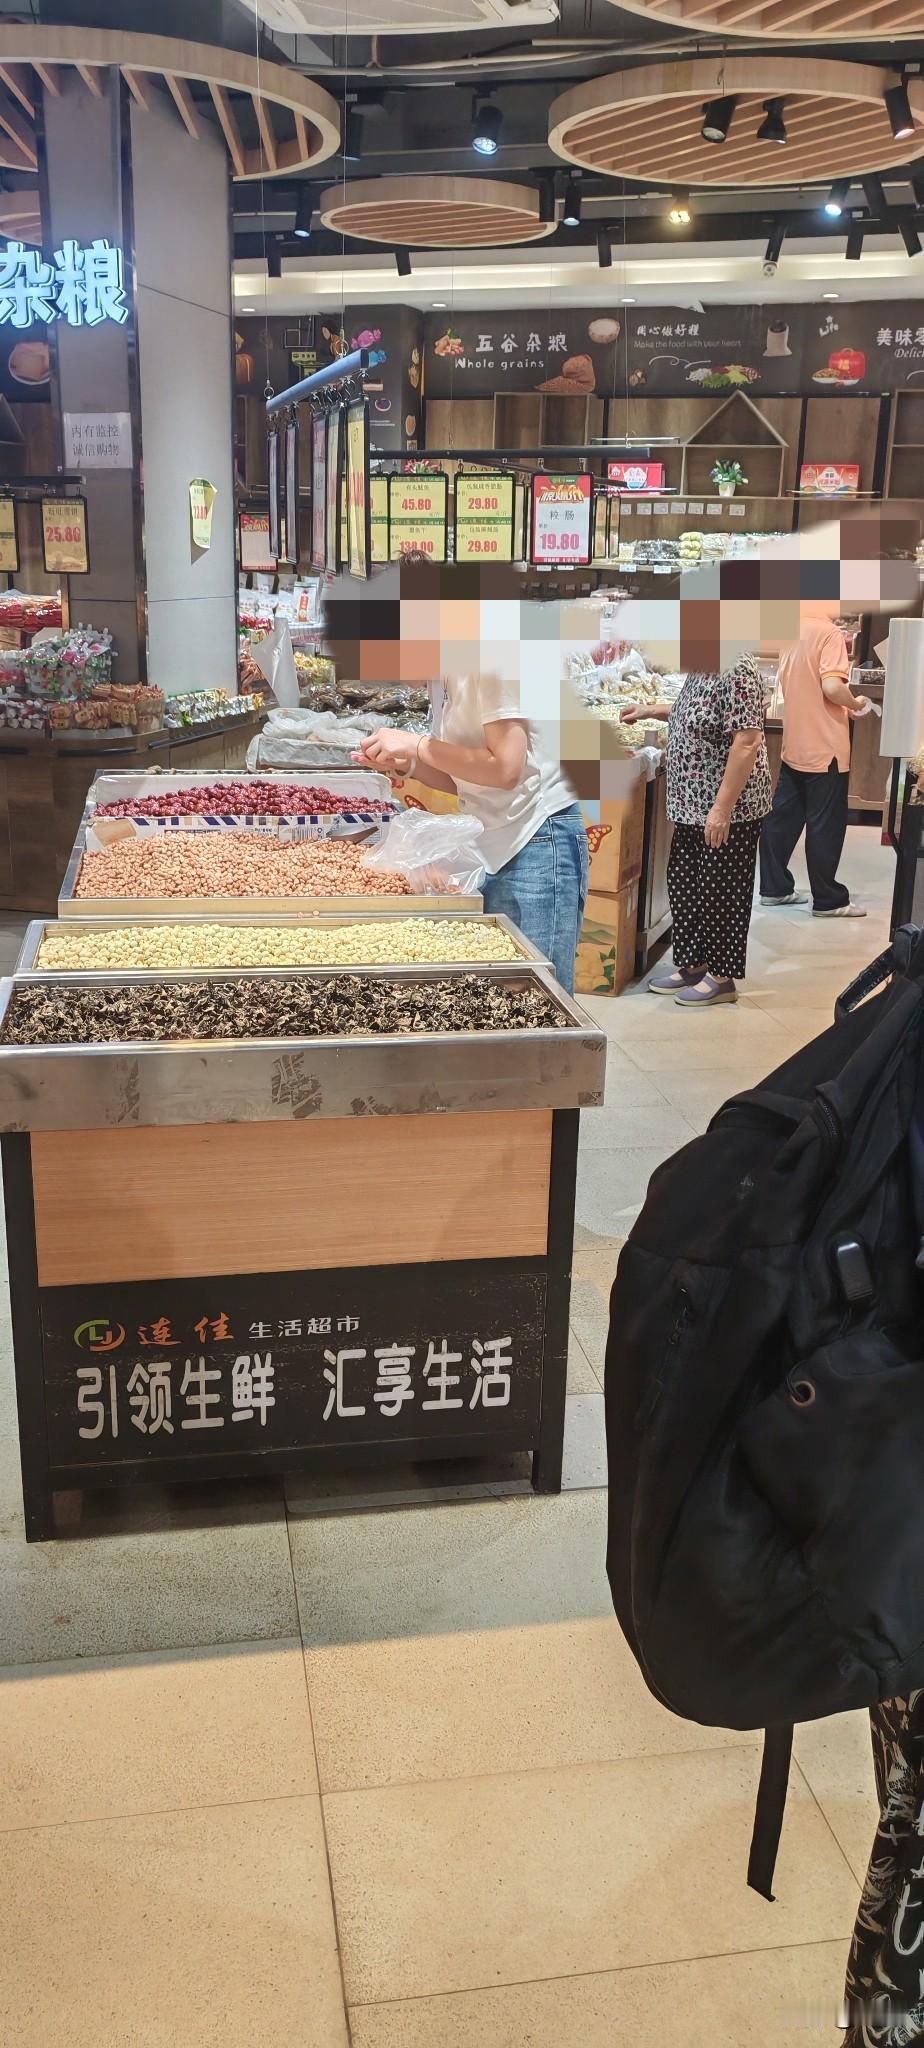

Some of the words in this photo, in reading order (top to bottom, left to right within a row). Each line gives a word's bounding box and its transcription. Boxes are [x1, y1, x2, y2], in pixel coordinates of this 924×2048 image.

[0, 239, 129, 329] 杂粮
[819, 323, 839, 337] Life
[475, 333, 568, 353] 五谷杂粮
[703, 341, 720, 349] your
[455, 358, 495, 369] Whole
[500, 359, 545, 371] grains
[71, 424, 120, 438] 内有监控
[72, 442, 120, 457] 诚信购物
[402, 498, 432, 511] 45.80
[468, 497, 498, 510] 29.80
[399, 540, 434, 553] 13800
[467, 540, 498, 553] 29.80
[540, 533, 579, 550] 19.80
[137, 1312, 235, 1347] 连佳
[248, 1315, 361, 1340] 生活超市
[77, 1352, 276, 1440] 引领生鲜
[323, 1337, 513, 1421] 汇享生活
